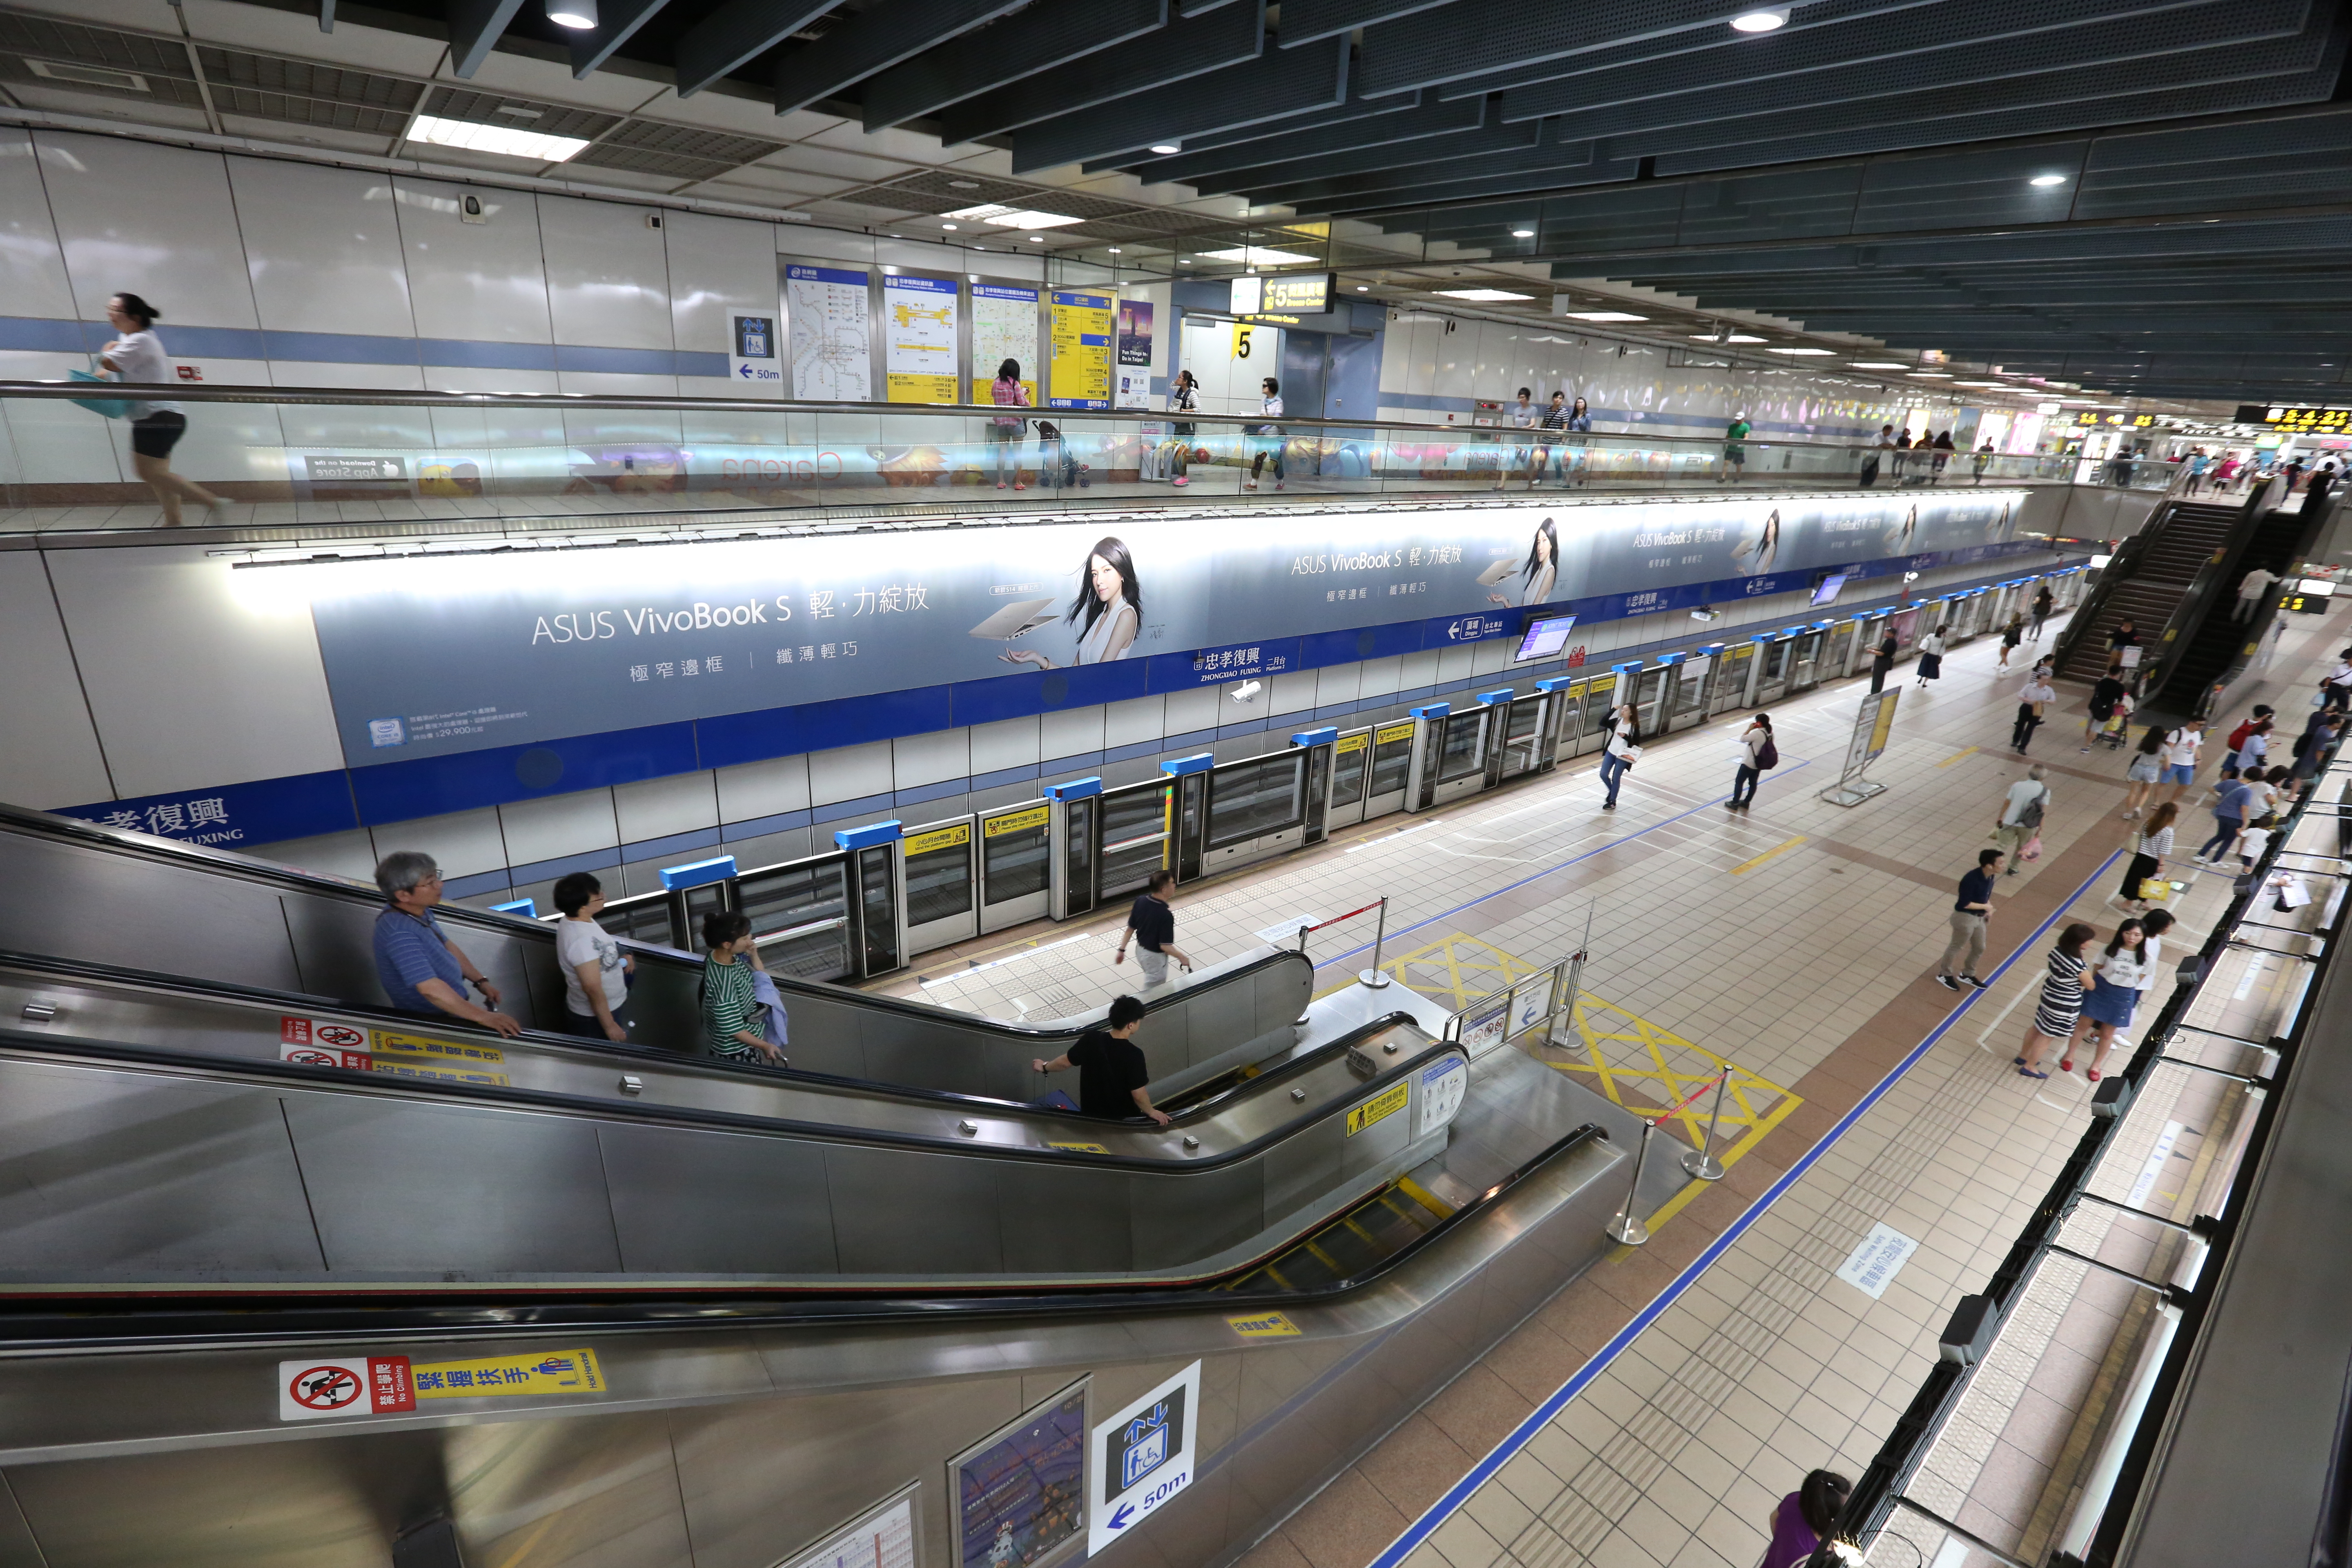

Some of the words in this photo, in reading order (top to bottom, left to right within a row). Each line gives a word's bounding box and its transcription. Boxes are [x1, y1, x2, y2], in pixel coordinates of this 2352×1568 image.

[1276, 284, 1287, 307] 5
[1283, 315, 1300, 324] Center
[1238, 331, 1250, 358] 5
[757, 370, 779, 379] 50m
[1633, 533, 1653, 548] ASUS
[1654, 531, 1686, 546] VivoBook
[1686, 530, 1693, 543] S
[1291, 554, 1327, 575] ASUS
[1330, 550, 1389, 570] VivoBook
[1394, 550, 1402, 567] S
[1326, 586, 1368, 603] 極窄邊框
[1389, 581, 1426, 596] 纖薄輕巧
[1631, 592, 1657, 607] 忠孝復興
[532, 611, 615, 645] ASUS
[623, 598, 768, 635] VivoBook
[775, 595, 791, 621] S
[1466, 620, 1479, 630] 頂埔
[1485, 621, 1503, 629] 台北車站
[776, 640, 858, 664] 纖薄輕巧
[1205, 647, 1260, 670] 忠孝復興
[629, 655, 724, 682] 極窄邊框
[1266, 656, 1286, 666] 二月台
[1201, 670, 1237, 682] ZHONGXIAO
[1240, 666, 1261, 676] FUXING
[79, 797, 229, 835] 孝復興
[1001, 812, 1043, 827] 關門時勿強行進出
[915, 833, 951, 846] 小心月台間隙
[1020, 946, 1048, 957] Waiting
[1048, 941, 1064, 950] Line
[295, 1020, 307, 1041] 禁止攀爬
[1368, 1088, 1405, 1114] 請勿倚靠側板
[1877, 1234, 1886, 1245] Safe
[1859, 1244, 1878, 1261] Waiting
[1851, 1261, 1865, 1273] Zone
[1859, 1236, 1907, 1289] 夜間安心候車區
[582, 1352, 592, 1374] Handrail
[379, 1363, 394, 1407] 禁止攀爬
[417, 1366, 530, 1390] 緊握扶手
[588, 1374, 598, 1389] Hold
[398, 1391, 406, 1403] No
[1142, 1470, 1186, 1510] 50m
